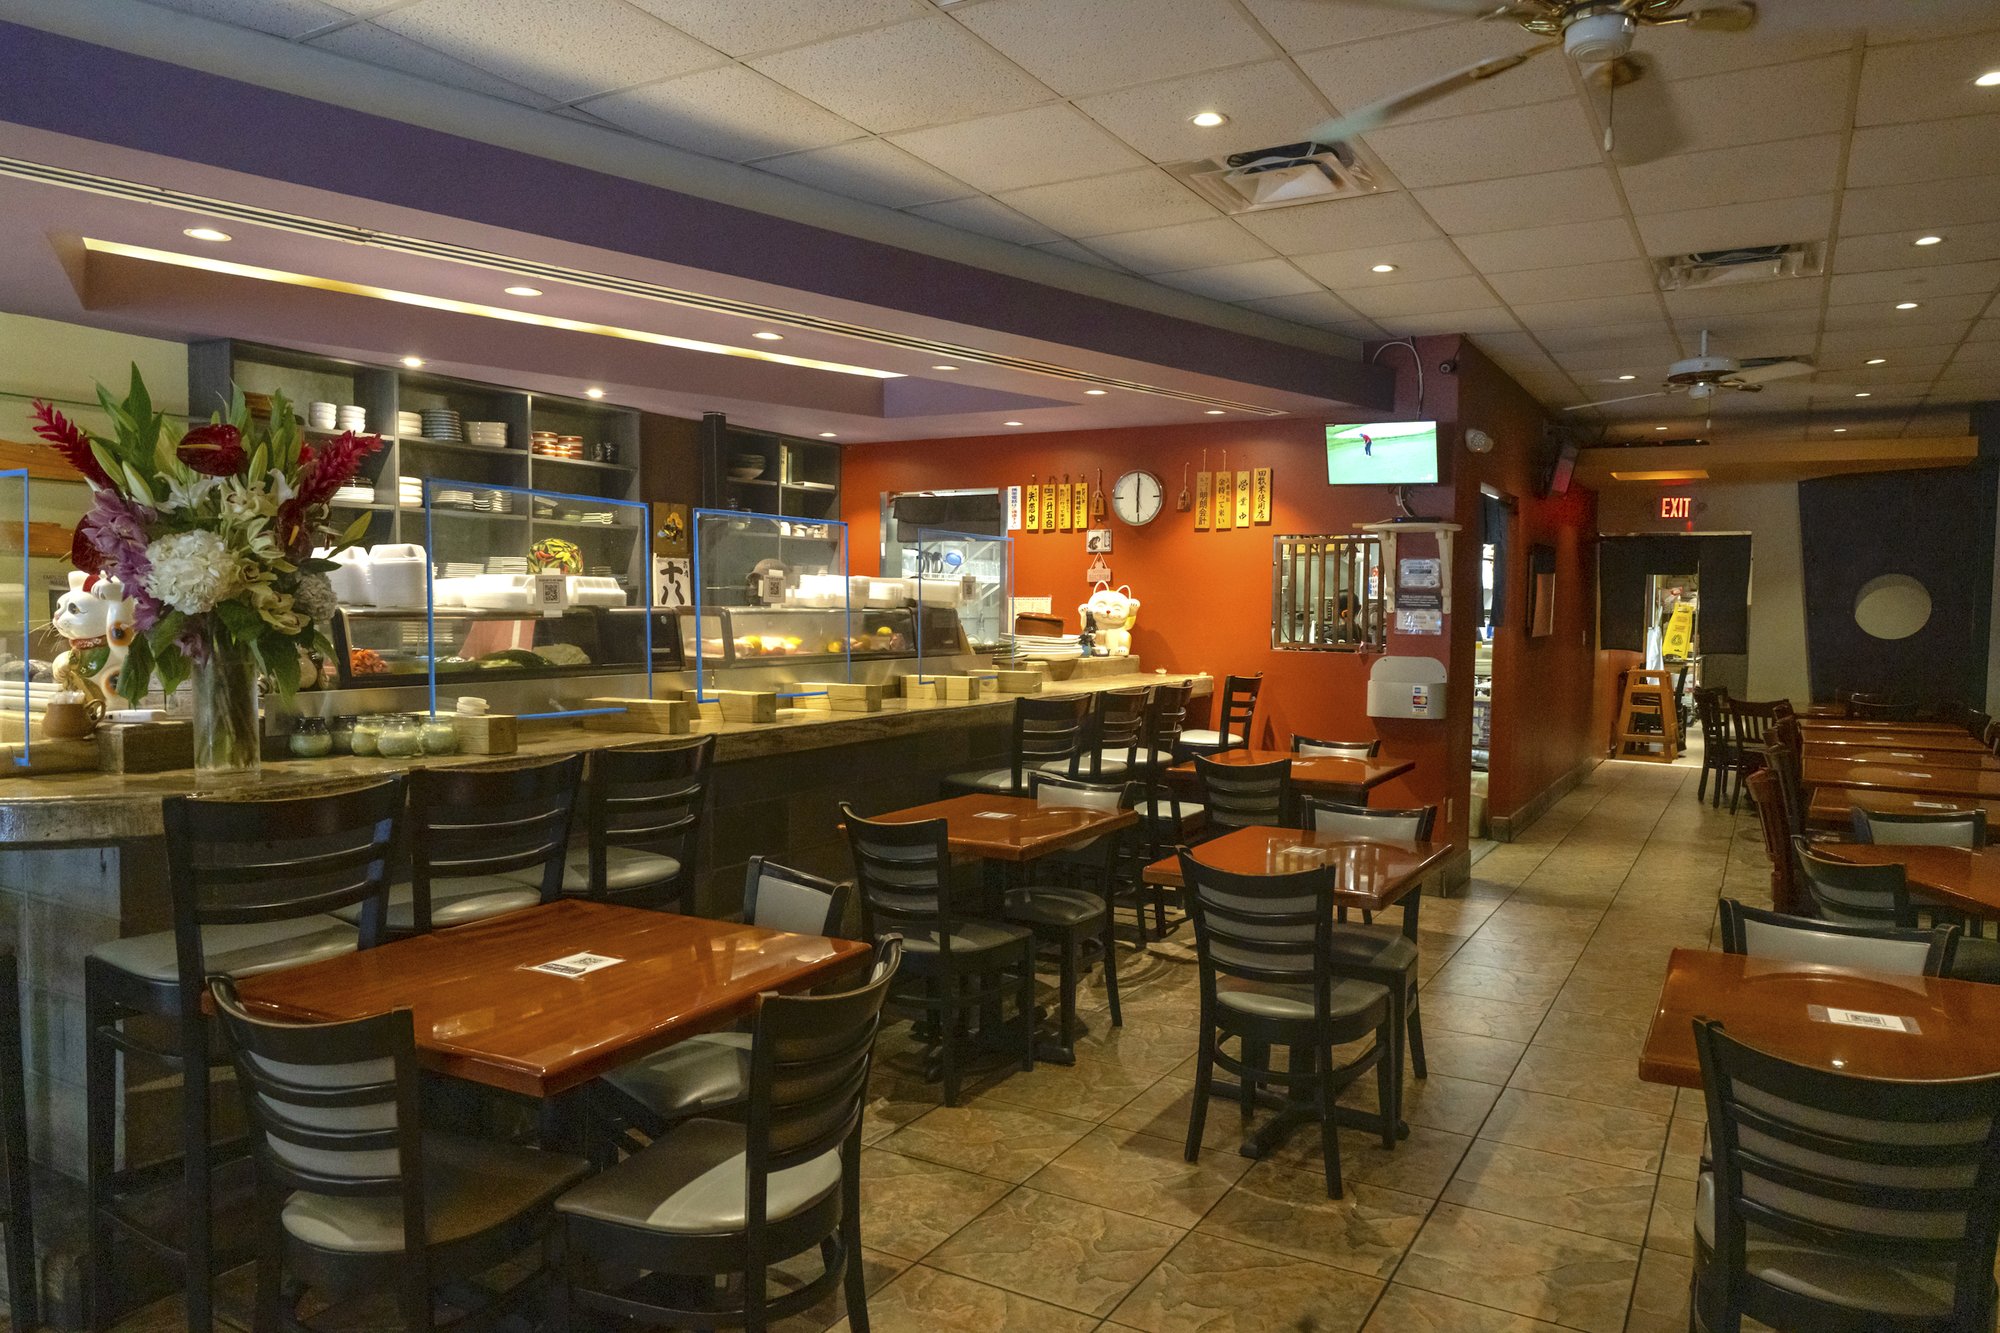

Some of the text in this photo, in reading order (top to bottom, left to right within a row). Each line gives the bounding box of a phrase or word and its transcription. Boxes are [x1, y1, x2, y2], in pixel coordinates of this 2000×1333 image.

[1238, 479, 1249, 520] 営業中
[1662, 497, 1692, 518] EXIT
[660, 561, 685, 605] 十八
